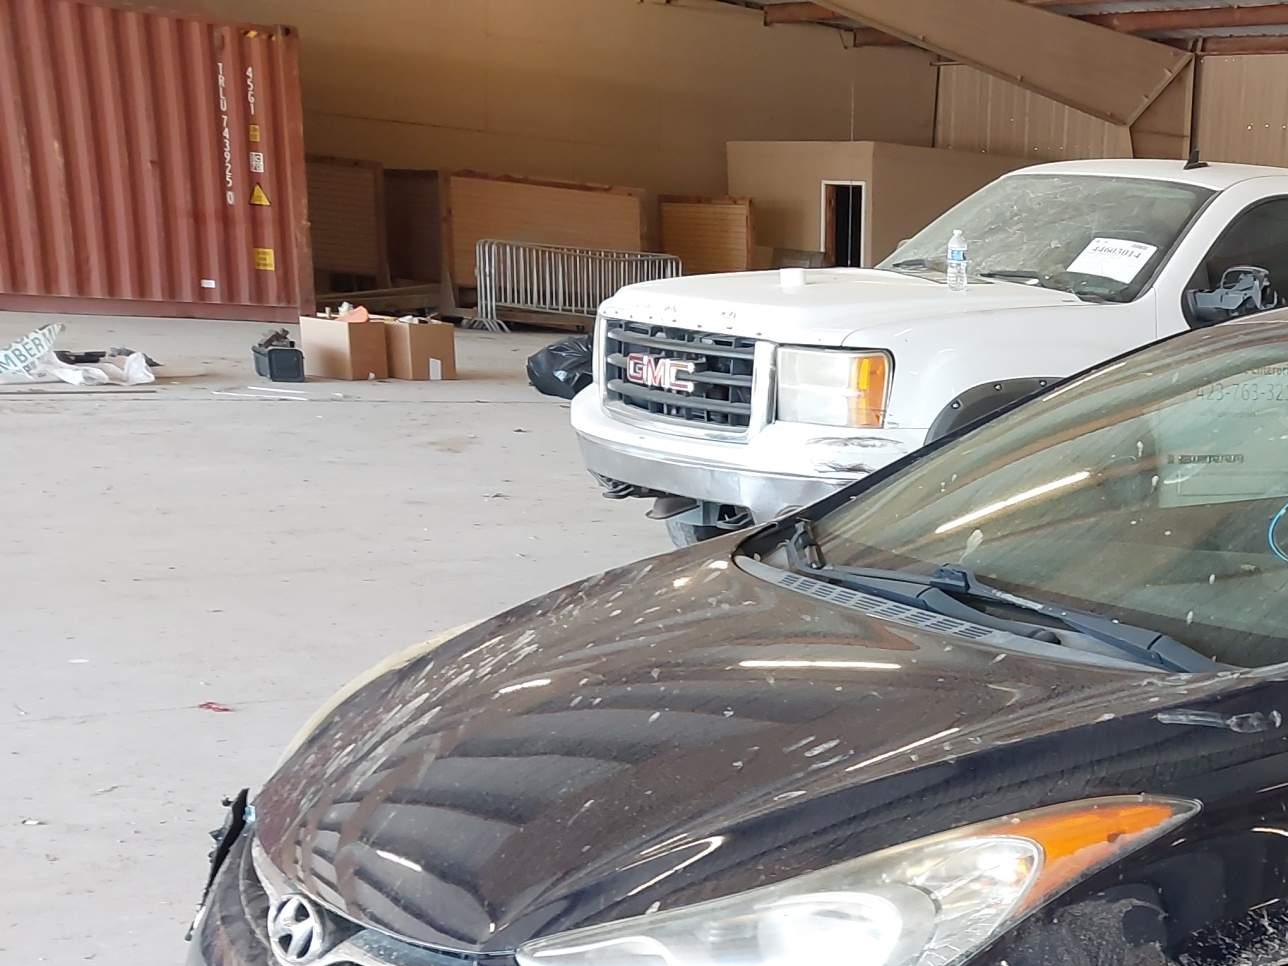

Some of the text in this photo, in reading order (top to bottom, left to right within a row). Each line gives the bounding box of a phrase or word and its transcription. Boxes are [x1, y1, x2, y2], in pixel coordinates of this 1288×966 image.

[246, 66, 255, 115] 45G1
[217, 62, 235, 206] TRLU 743925 0
[626, 352, 696, 393] GMC
